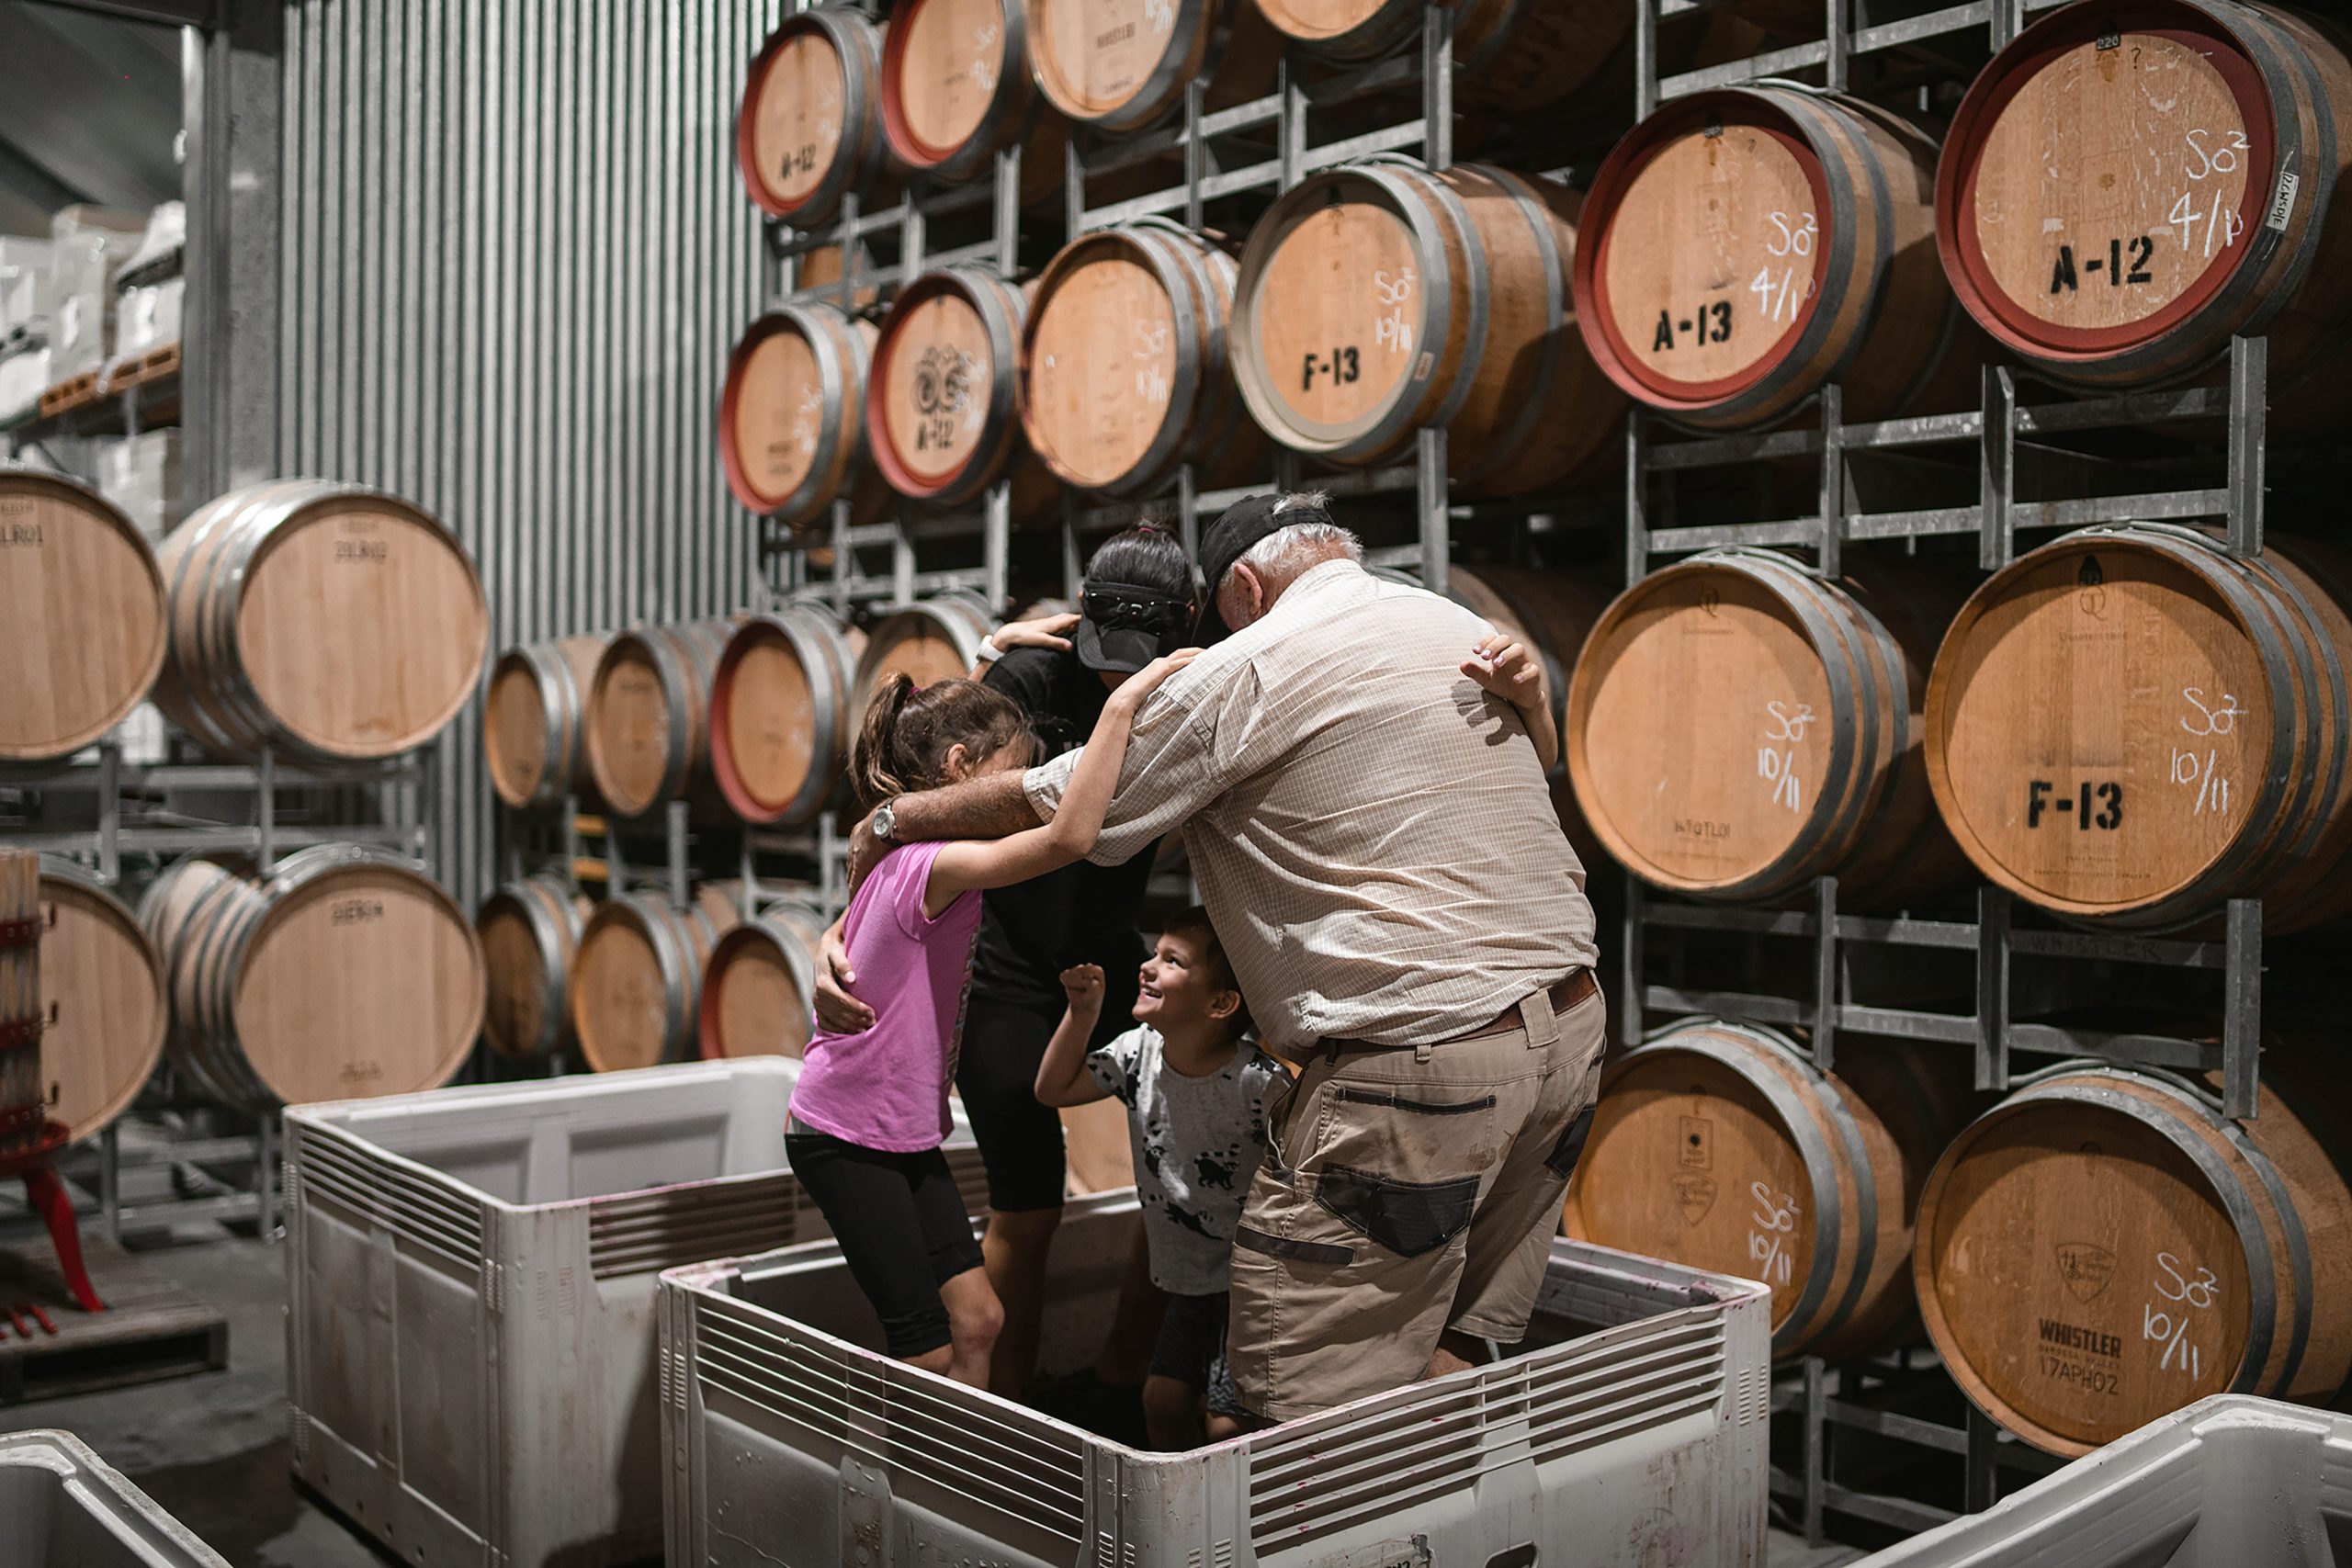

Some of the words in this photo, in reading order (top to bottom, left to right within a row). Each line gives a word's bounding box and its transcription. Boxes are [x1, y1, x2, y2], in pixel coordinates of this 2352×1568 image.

[2051, 235, 2154, 294] A-12
[1653, 300, 1732, 352] A-13
[1302, 345, 1360, 392] F-13
[1758, 747, 1800, 814] 10/11
[2028, 780, 2123, 830] F-13
[2171, 747, 2229, 816] 10/11
[1748, 1229, 1792, 1286] 10/11
[2039, 1317, 2121, 1359] WHISTLER
[2143, 1303, 2199, 1382] 10/11
[2039, 1355, 2120, 1396] 17APH02
